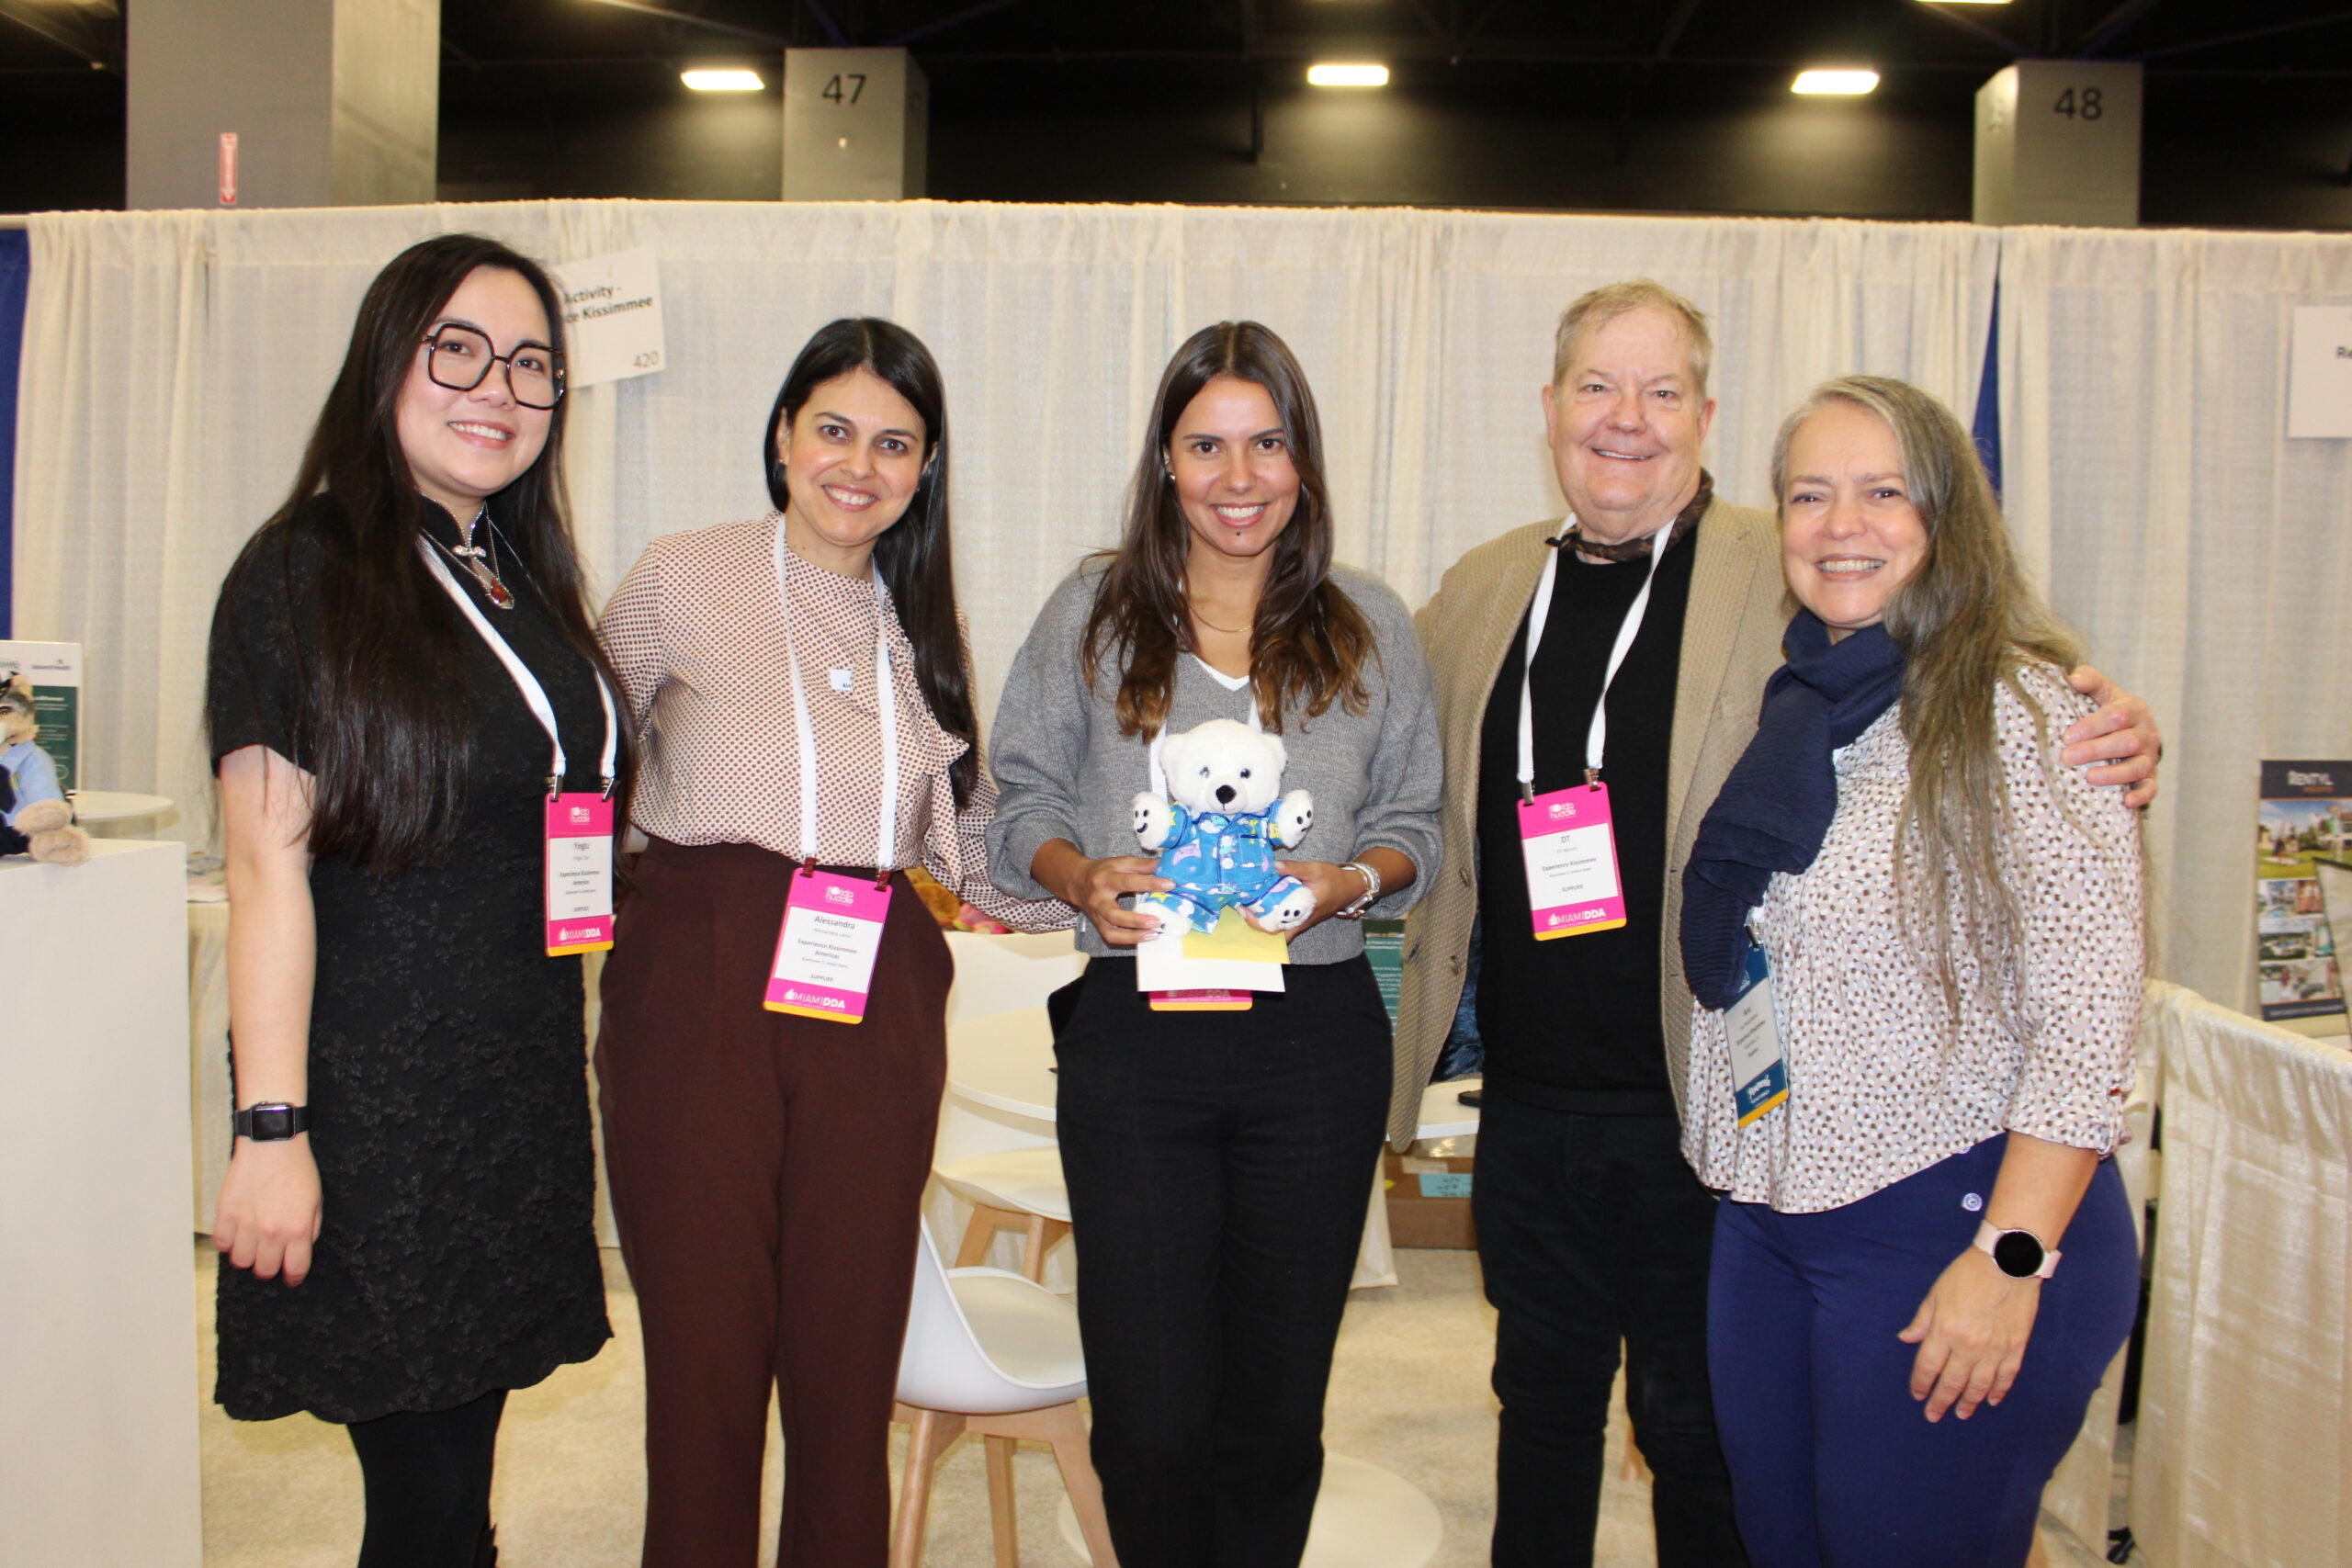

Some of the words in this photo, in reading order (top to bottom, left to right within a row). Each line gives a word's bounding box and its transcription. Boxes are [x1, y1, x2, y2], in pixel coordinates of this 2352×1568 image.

[822, 73, 866, 105] 47
[2052, 87, 2103, 120] 48
[582, 297, 653, 320] Kissimmee
[633, 351, 660, 368] 420
[1560, 835, 1571, 844] DT
[825, 894, 854, 905] huddle
[814, 916, 856, 930] Alessandra
[1556, 908, 1607, 925] MIAMIDDA
[797, 938, 828, 949] Experience
[809, 973, 834, 983] SUPPLIER
[794, 991, 846, 1010] MIAMIDDA
